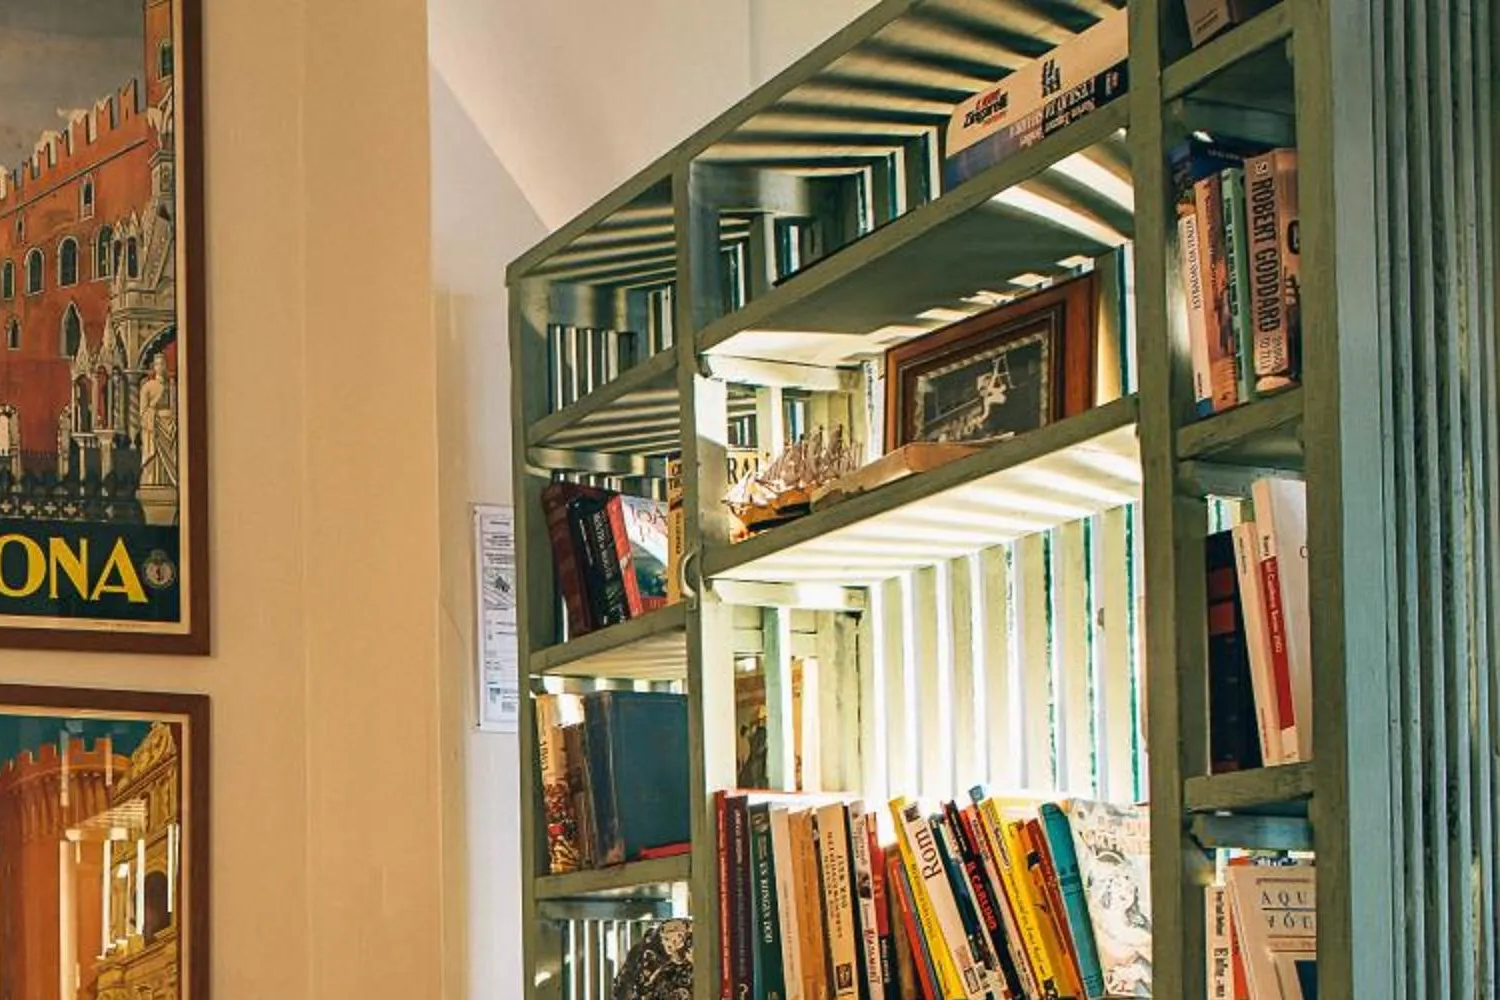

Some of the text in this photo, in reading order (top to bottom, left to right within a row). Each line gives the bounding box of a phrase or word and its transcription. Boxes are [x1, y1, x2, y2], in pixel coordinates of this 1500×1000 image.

[1252, 177, 1282, 333] ROBERT GODDARD
[914, 827, 942, 880] Rom
